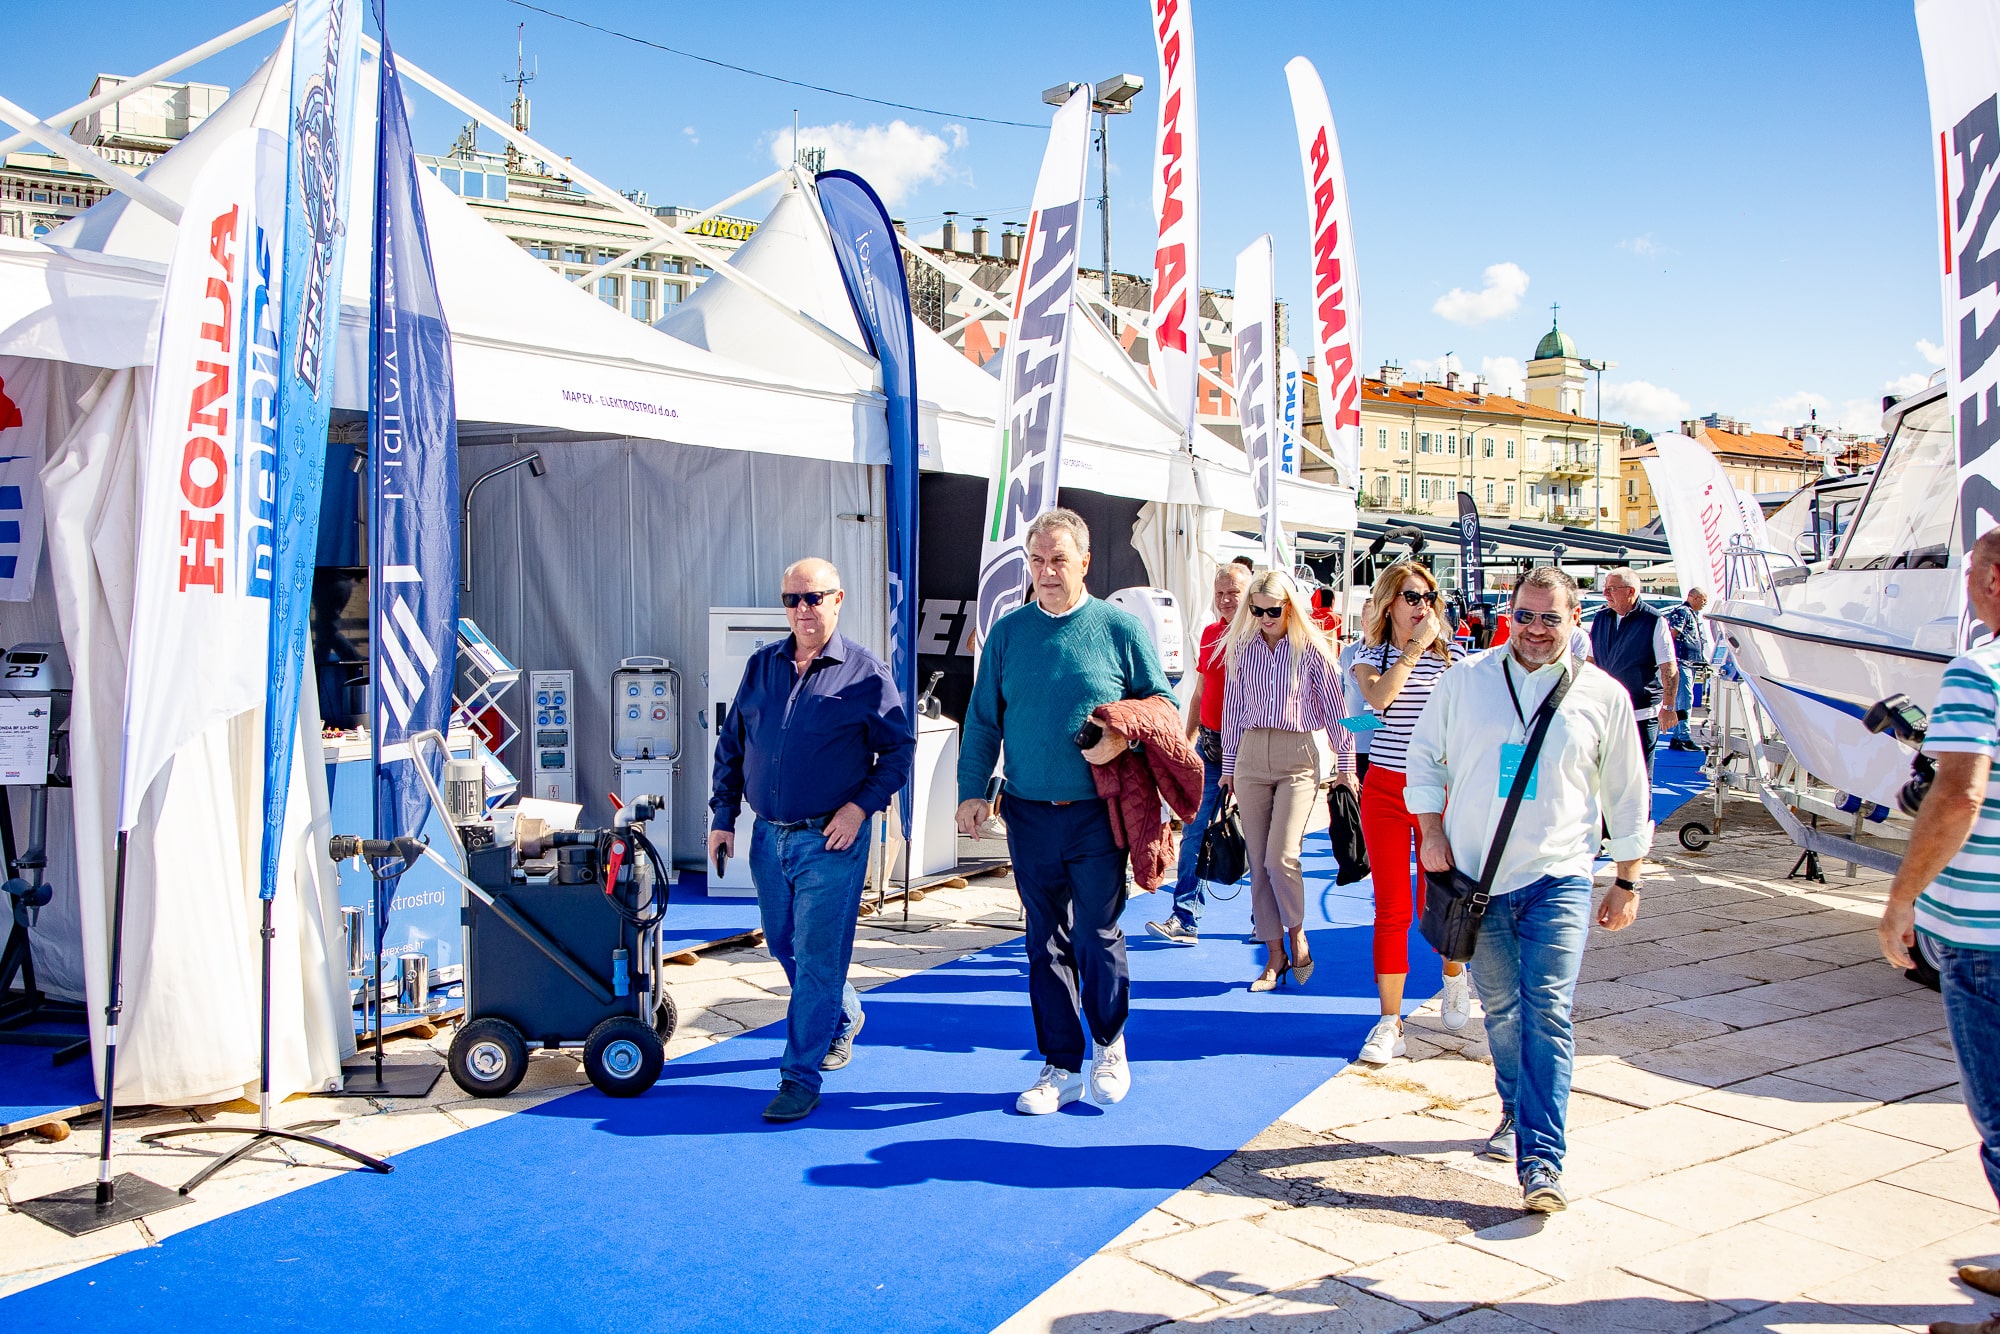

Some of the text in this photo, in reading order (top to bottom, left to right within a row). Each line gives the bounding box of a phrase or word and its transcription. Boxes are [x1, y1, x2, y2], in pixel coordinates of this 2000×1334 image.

[301, 242, 326, 386] PENTA
[179, 203, 239, 594] HONDA
[368, 887, 445, 916] Ektrostroj
